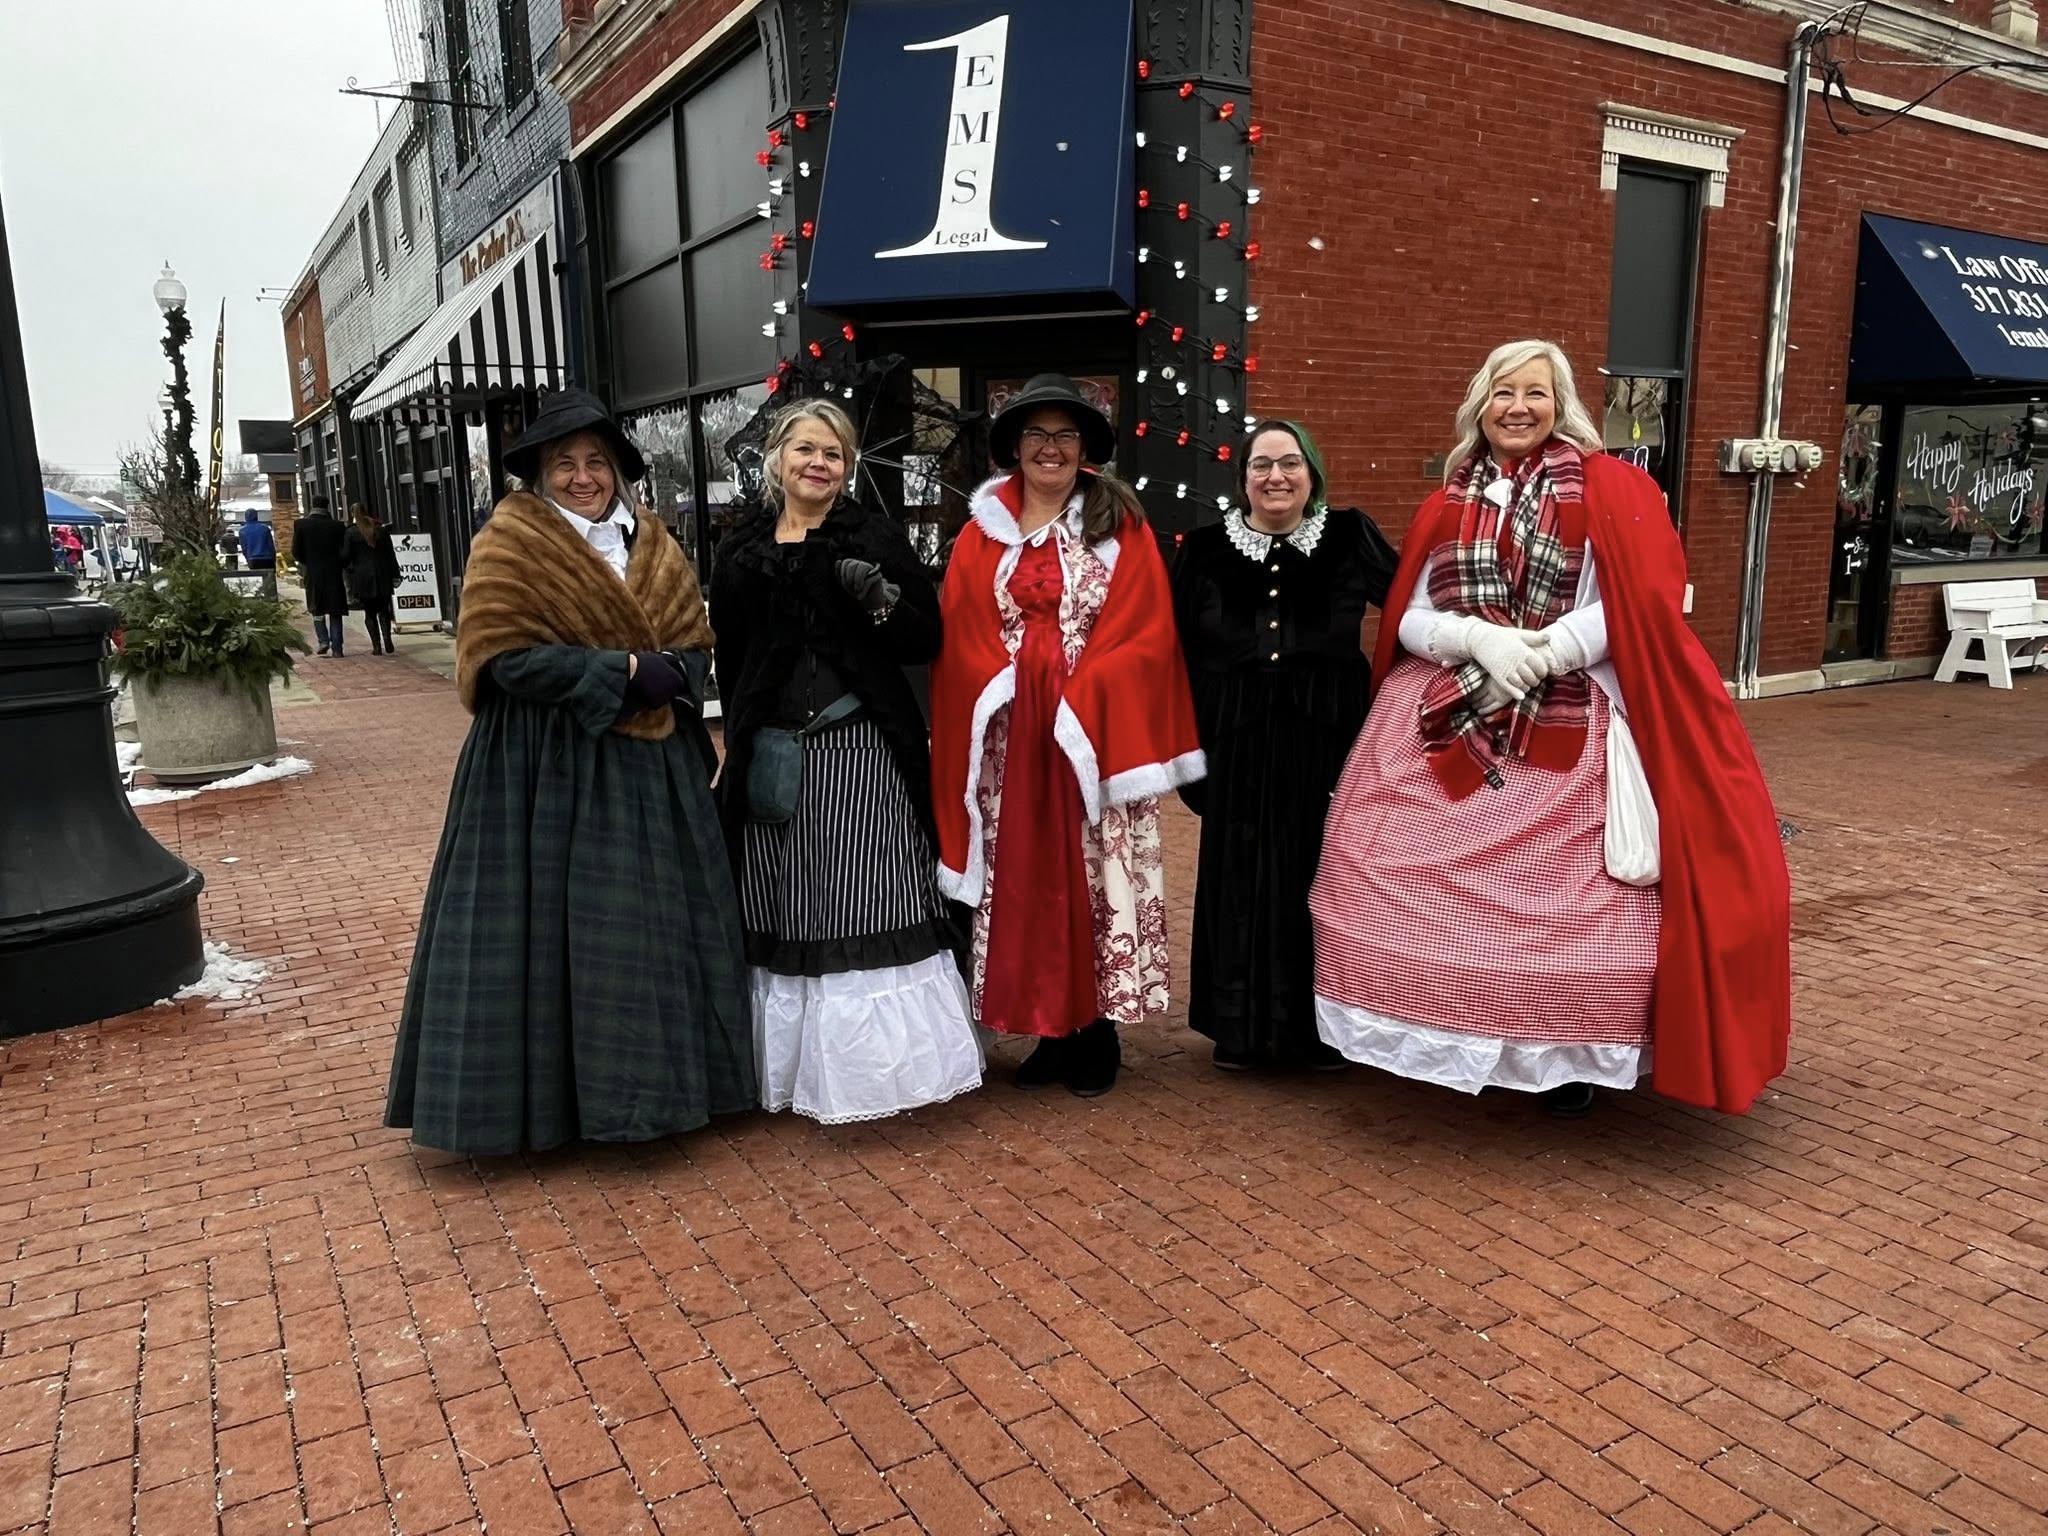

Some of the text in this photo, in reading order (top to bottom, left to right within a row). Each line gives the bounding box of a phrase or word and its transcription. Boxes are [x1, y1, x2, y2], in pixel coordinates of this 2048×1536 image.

[934, 228, 989, 248] Legal
[1940, 246, 2003, 279] Law
[1906, 431, 1965, 493] Happy
[1967, 458, 2033, 524] Holidays
[400, 564, 433, 573] NTIQUE
[401, 575, 427, 583] MALL
[399, 597, 432, 608] OPEN
